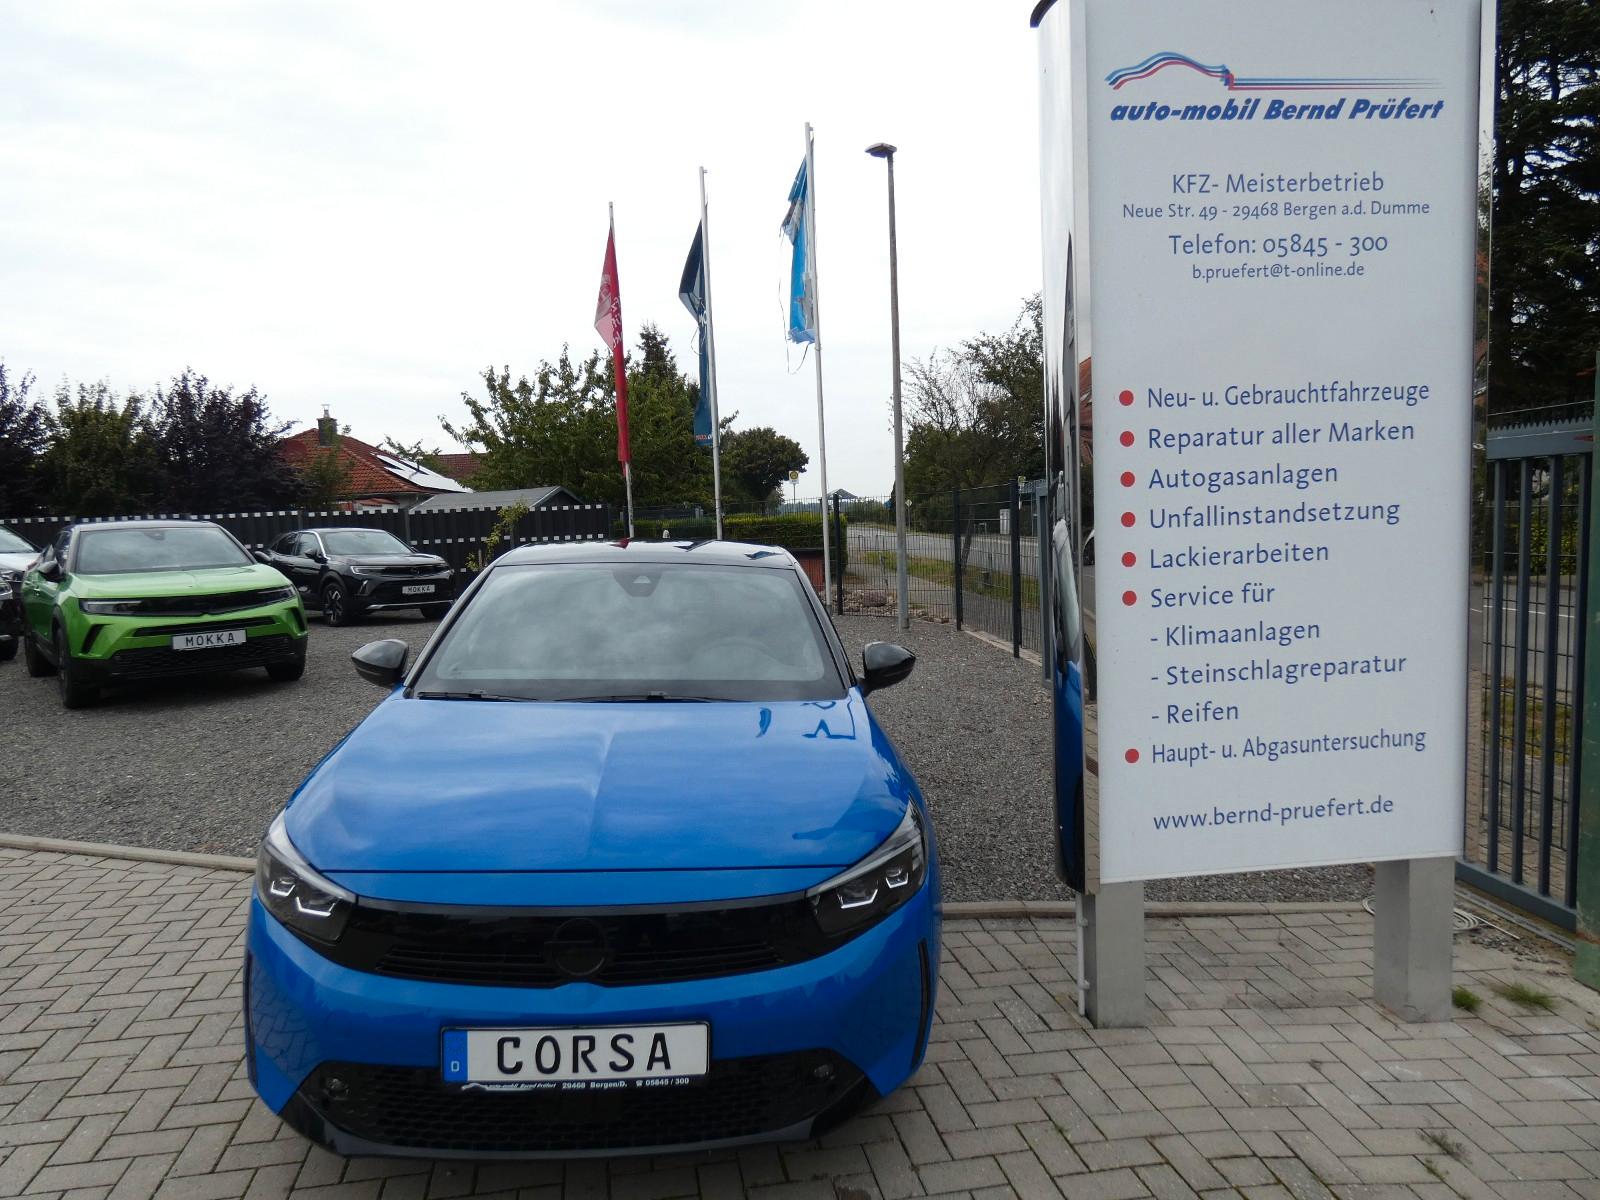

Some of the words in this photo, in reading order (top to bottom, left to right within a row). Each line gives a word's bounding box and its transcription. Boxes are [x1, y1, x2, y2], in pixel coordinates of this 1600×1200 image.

[1110, 97, 1262, 121] auto-mobil
[1263, 97, 1345, 121] Bernd
[1348, 97, 1445, 120] Prüfert
[1173, 174, 1219, 194] KFZ-
[1226, 170, 1384, 193] Meisterbetrieb
[1123, 203, 1163, 219] Neue
[1168, 203, 1195, 218] Str.
[1198, 206, 1218, 222] 49
[1232, 201, 1279, 221] 29468
[1283, 201, 1337, 221] Bergen
[1341, 199, 1366, 216] a.d.
[1370, 200, 1430, 215] Dumme
[1168, 232, 1256, 255] Telefon:
[1262, 234, 1328, 258] 05845
[1349, 236, 1388, 257] 300
[1192, 261, 1365, 283] b.pruefert@t-online.de
[1148, 387, 1196, 409] Neu-
[1202, 391, 1219, 407] u.
[1224, 380, 1430, 407] Gebrauchtfahrzeuge
[1148, 427, 1265, 455] Reparatur
[1271, 422, 1321, 445] aller
[1328, 419, 1414, 443] Marken
[1148, 462, 1337, 494] Autogasanlagen
[1150, 501, 1401, 529] Unfallinstandsetzung
[1150, 542, 1329, 569] Lackierarbeiten
[407, 585, 431, 593] MOKKA
[1150, 585, 1234, 608] Service
[1241, 582, 1275, 604] für
[185, 632, 236, 647] MOKKA
[1166, 620, 1320, 647] Klimaanlagen
[1166, 655, 1407, 686] Steinschlagreparatur
[1167, 700, 1239, 724] Reifen
[1152, 742, 1216, 768] Haupt-
[1221, 744, 1237, 759] u.
[1242, 728, 1427, 762] Abgasuntersuchung
[1153, 794, 1394, 830] www.bernd-pruefert.de
[450, 1060, 460, 1073] D
[496, 1032, 672, 1075] CORSA
[675, 1077, 690, 1085] 300
